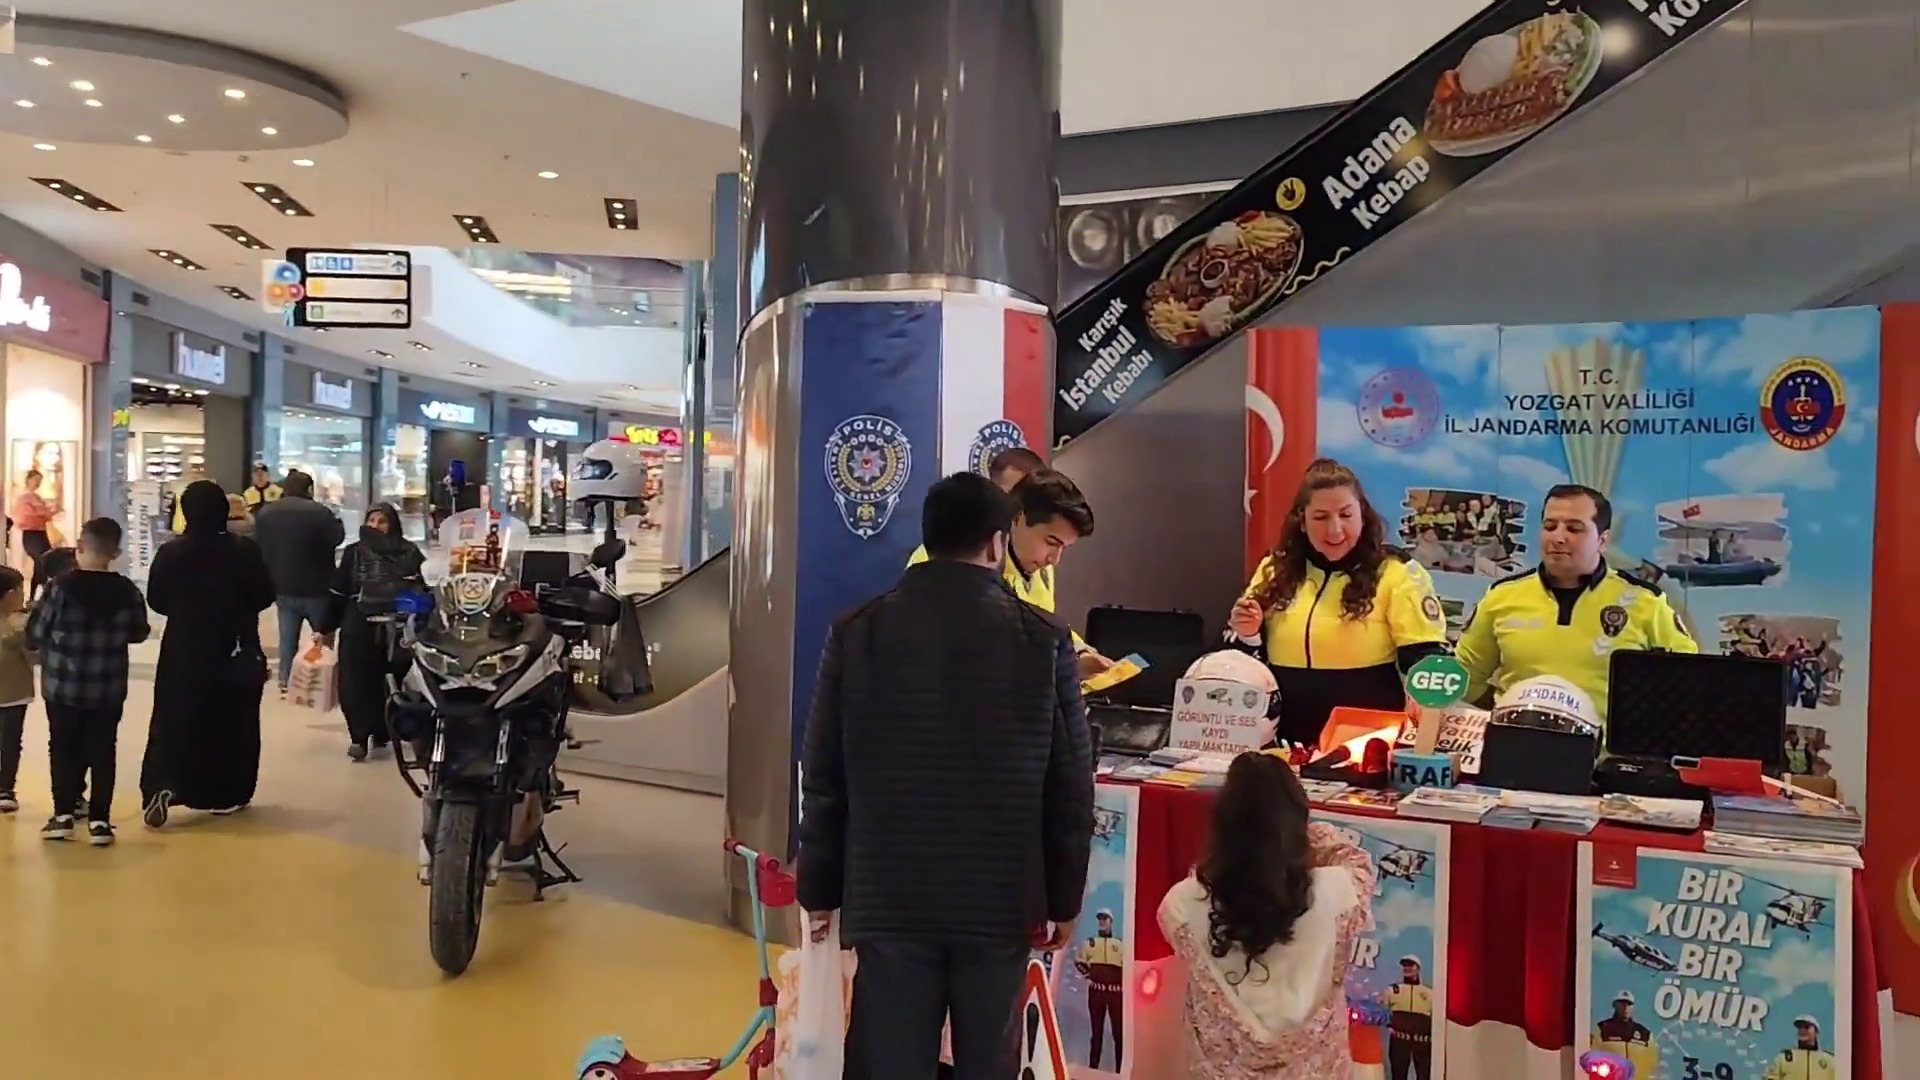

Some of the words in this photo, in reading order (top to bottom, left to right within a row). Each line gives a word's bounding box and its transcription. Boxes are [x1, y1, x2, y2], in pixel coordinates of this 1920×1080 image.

[1322, 116, 1417, 210] Adana
[1350, 156, 1430, 230] Kebap
[1078, 297, 1128, 352] Karışık
[1102, 349, 1154, 404] Kebabı
[1578, 368, 1619, 385] T.C.
[1504, 394, 1596, 411] YOZGAT
[1602, 387, 1695, 410] VALİLİĞİ
[843, 419, 893, 436] POLİS
[1445, 414, 1463, 434] İL
[1468, 417, 1593, 436] JANDARMA
[1600, 411, 1756, 436] KOMUTANLIĞI
[1769, 426, 1835, 449] JANDARMA
[1411, 670, 1461, 695] GEÇ
[1518, 688, 1581, 712] JANDARMA
[1238, 715, 1258, 728] SES
[1678, 867, 1743, 905] BİR
[1646, 901, 1772, 948] KURAL
[1676, 943, 1743, 982] BİR
[1654, 977, 1769, 1031] ÖMÜR
